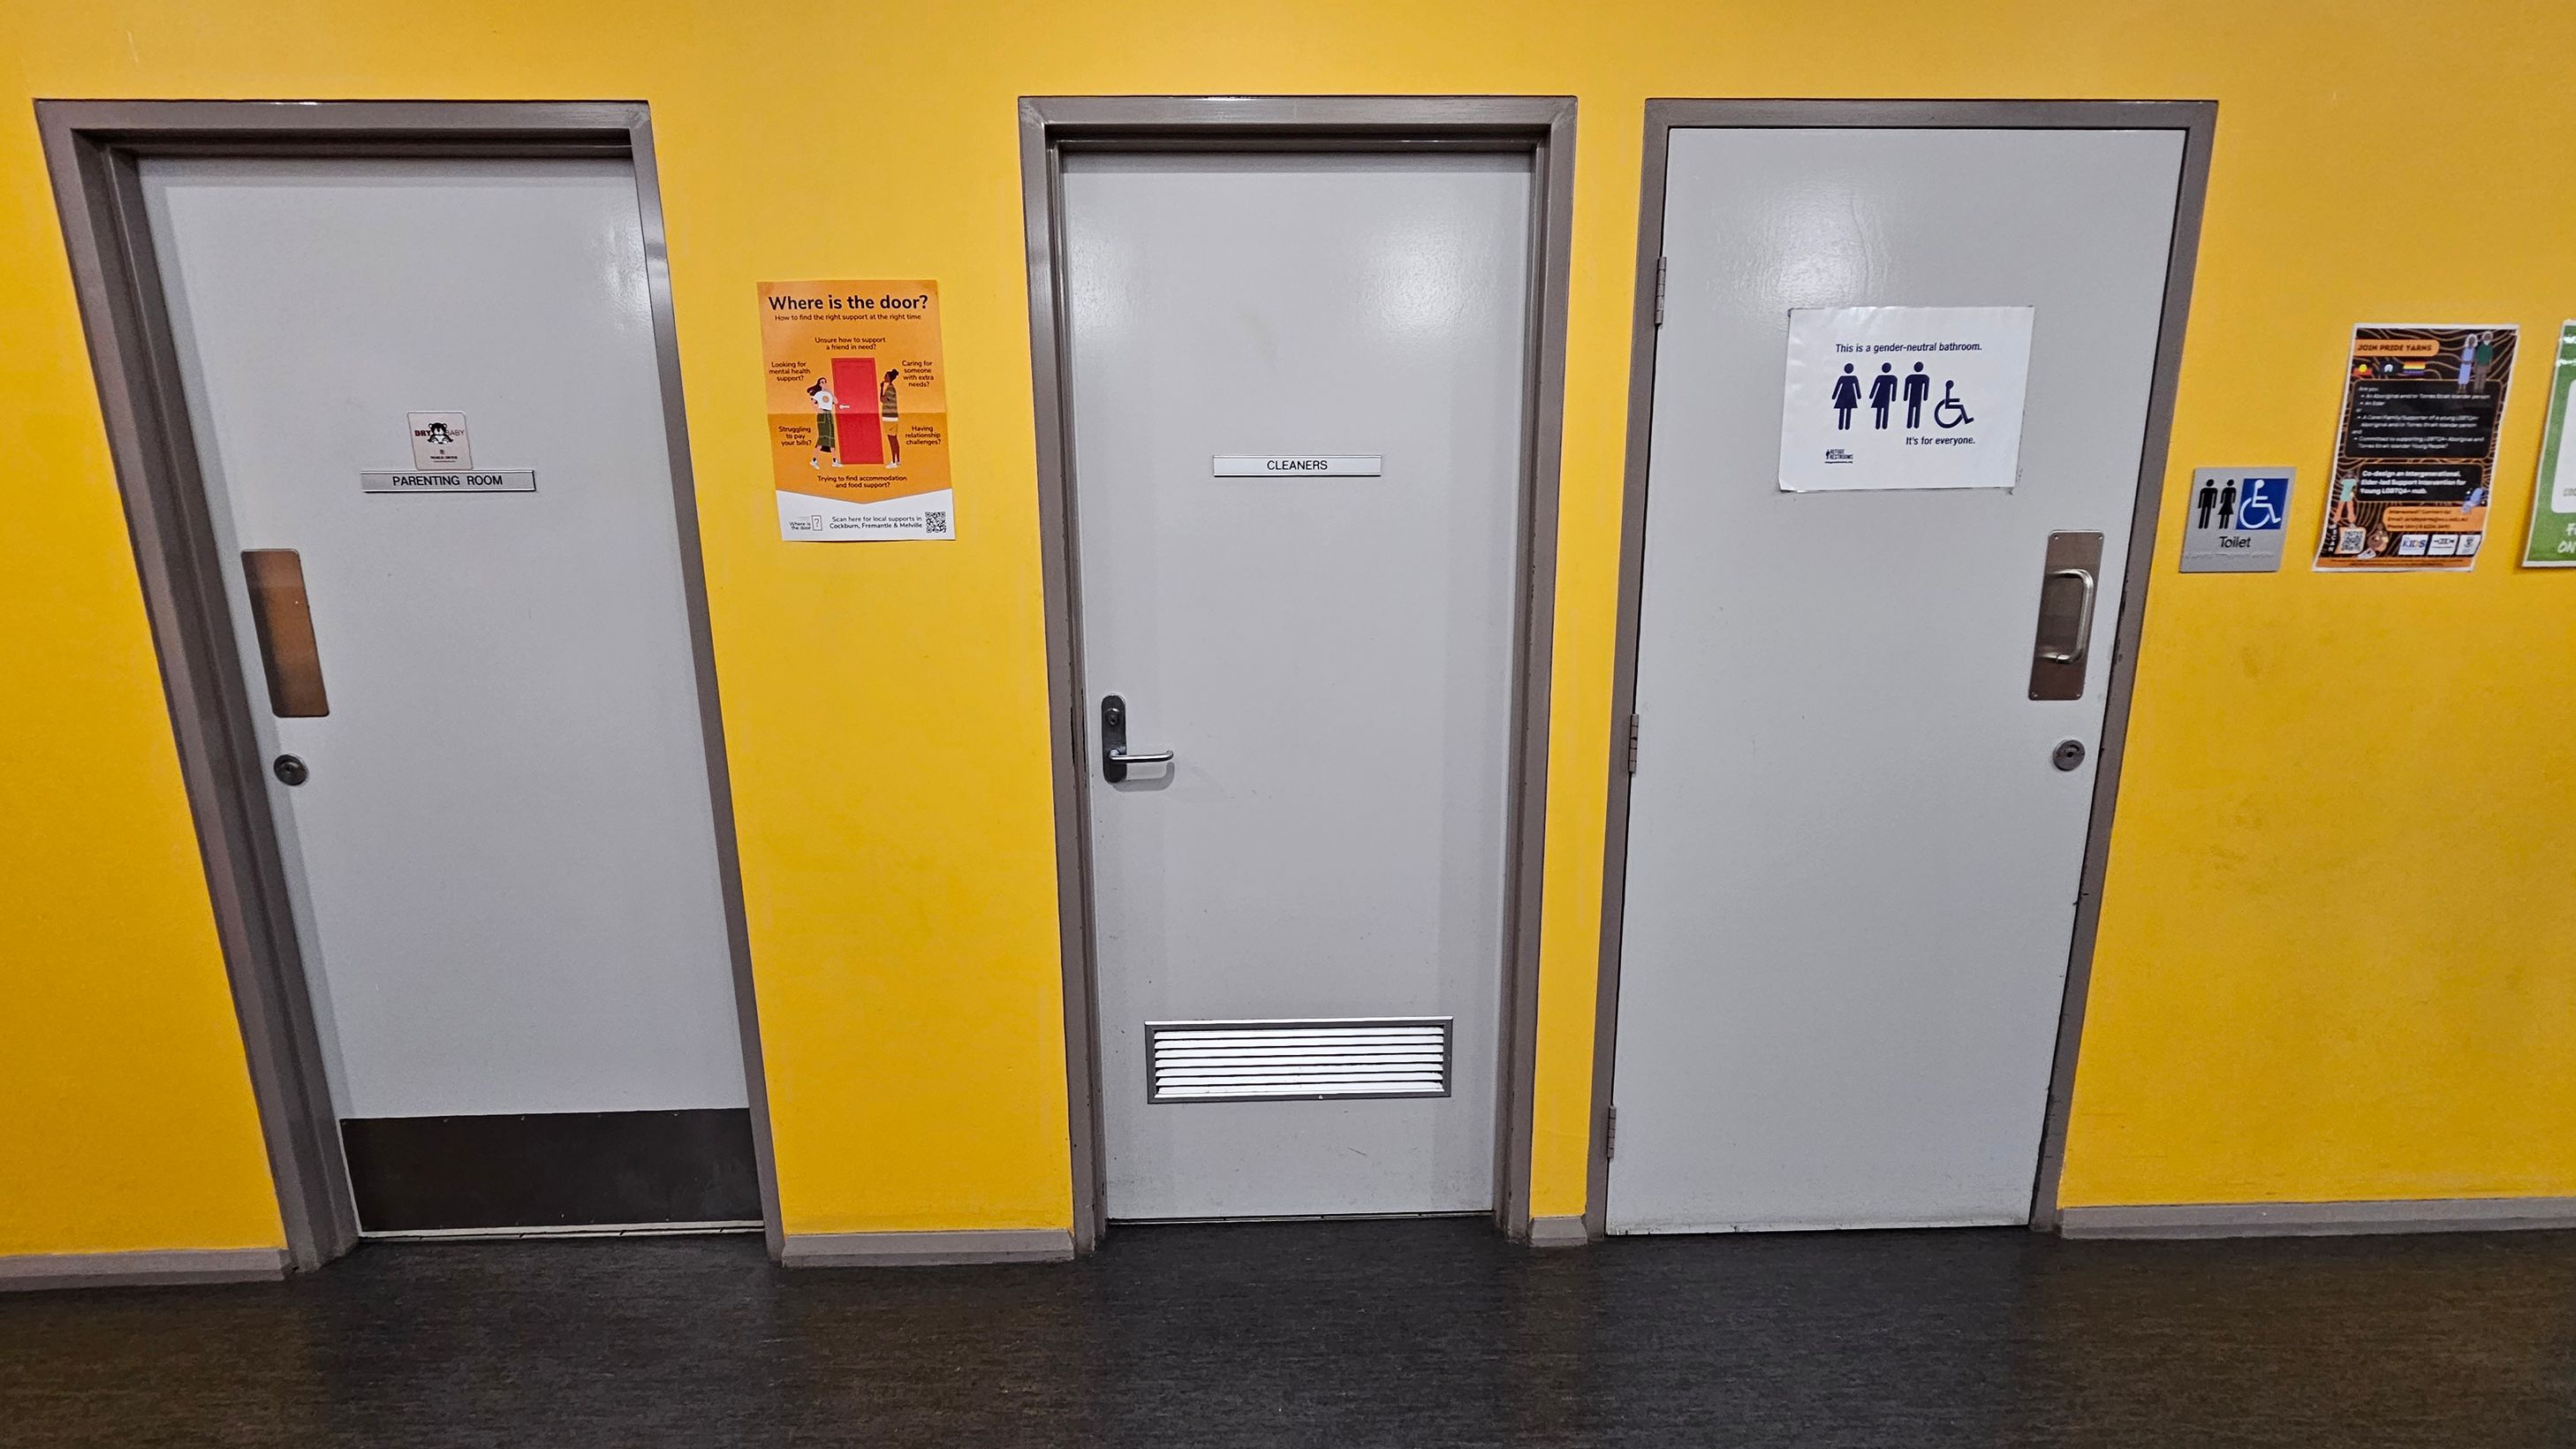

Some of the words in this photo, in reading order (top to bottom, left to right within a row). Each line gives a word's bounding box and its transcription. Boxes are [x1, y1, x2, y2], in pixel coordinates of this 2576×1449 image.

[769, 296, 823, 310] Where
[829, 295, 843, 309] is
[847, 295, 875, 309] the
[880, 294, 928, 309] door?
[1836, 343, 1853, 353] This
[1856, 343, 1863, 353] is
[1874, 342, 1936, 353] gender-neutral
[1939, 342, 1982, 352] bathroom.
[1905, 436, 1919, 445] It's
[1921, 436, 1934, 445] for
[1935, 436, 1976, 446] everyone.
[1267, 460, 1328, 470] CLEANERS
[392, 475, 459, 486] PARENTING
[467, 475, 503, 486] ROOM
[2219, 536, 2251, 548] Toilet
